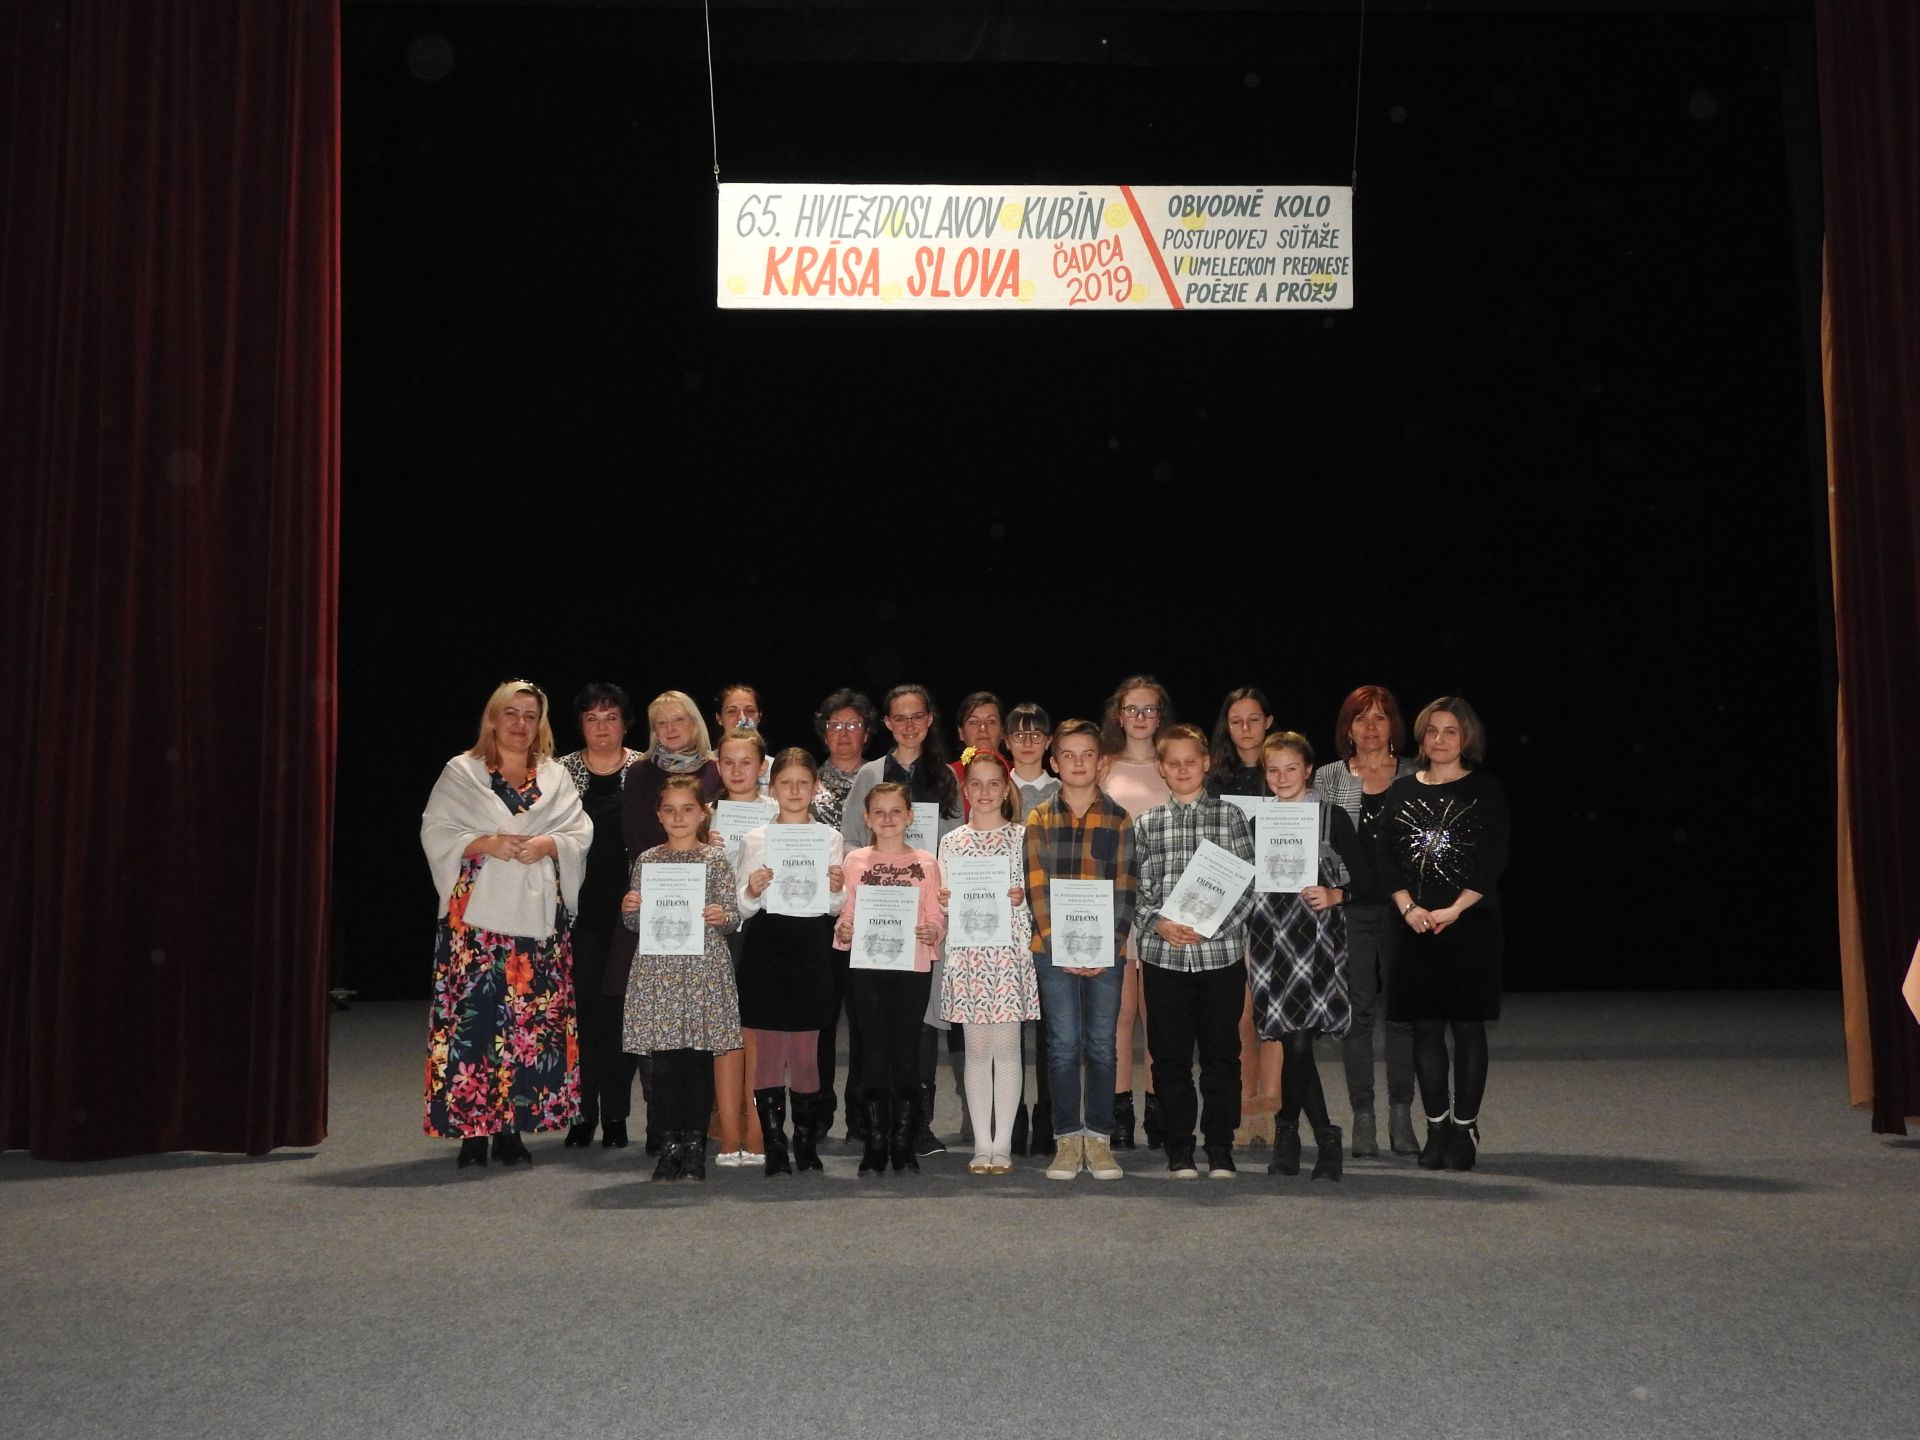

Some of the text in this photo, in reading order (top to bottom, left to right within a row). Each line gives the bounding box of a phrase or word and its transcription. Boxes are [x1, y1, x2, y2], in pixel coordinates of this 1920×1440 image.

[1168, 189, 1330, 217] OBVODNÉ KOLO
[737, 191, 1105, 240] 65. HVIEZDOSLAVOV KUBÍN
[1163, 229, 1267, 249] POSTUPOVEJ
[1053, 234, 1124, 279] ČADCA
[1174, 256, 1350, 276] V UMELECKOM PREDNESE
[762, 240, 1020, 297] KRÁSA SLOVA
[1066, 266, 1132, 306] 2019
[1185, 279, 1248, 303] POÉZIE
[1255, 283, 1267, 302] A
[782, 859, 815, 867] DIPLOM
[873, 864, 909, 879] Tokyo
[963, 892, 995, 900] DIPLOM
[1196, 877, 1226, 896] DIPLOM
[656, 899, 689, 907] DIPLOM
[869, 918, 902, 926] DIPLOM
